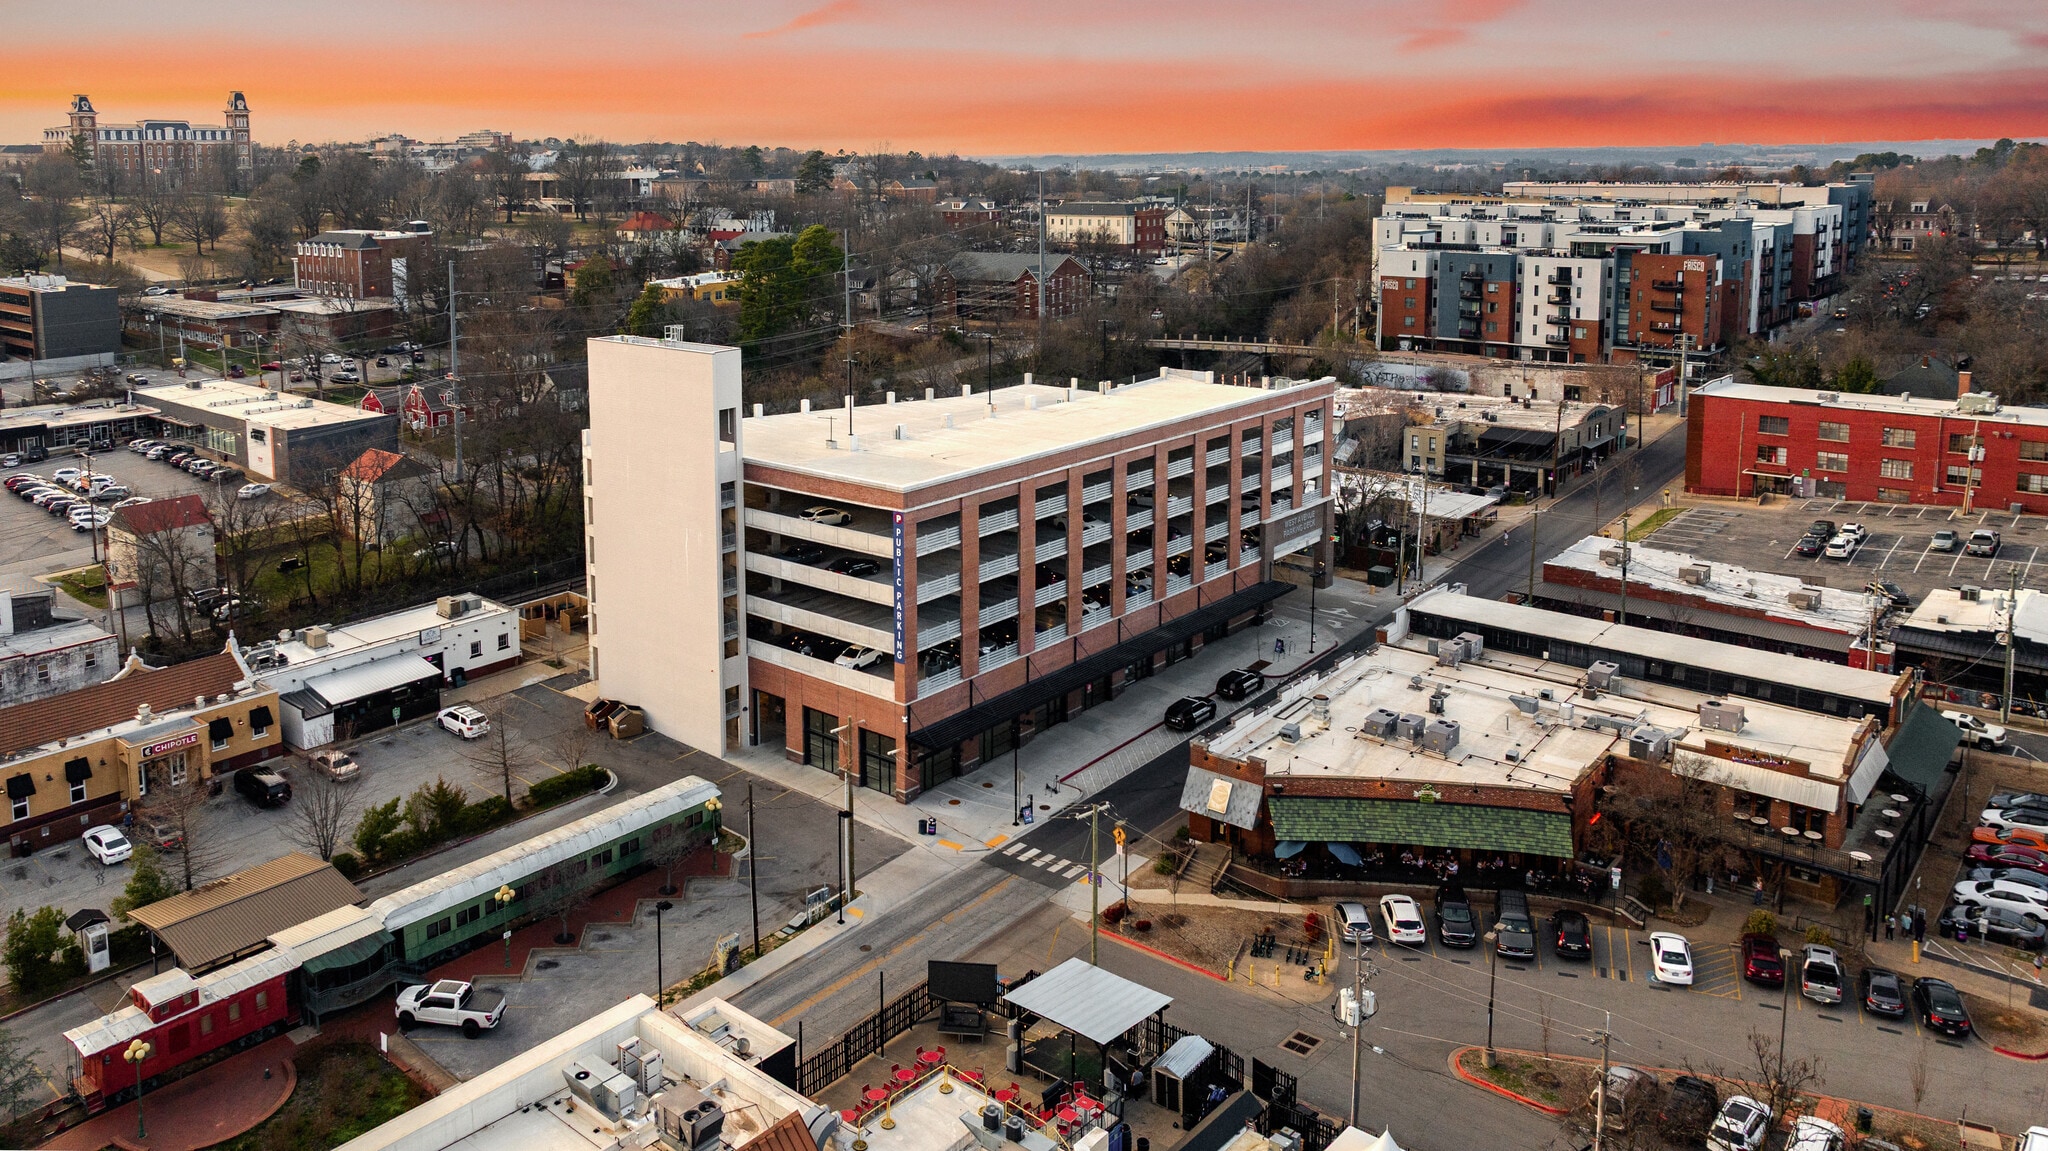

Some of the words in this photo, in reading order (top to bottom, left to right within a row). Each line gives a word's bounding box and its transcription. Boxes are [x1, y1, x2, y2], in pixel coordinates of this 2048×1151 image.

[1683, 261, 1705, 272] FRISCO
[896, 515, 902, 523] P
[1284, 517, 1297, 528] WEST
[1297, 510, 1315, 523] AVENUE
[1283, 524, 1303, 538] PARKING
[1303, 519, 1316, 530] DECK
[155, 735, 197, 752] CHIPOTLE
